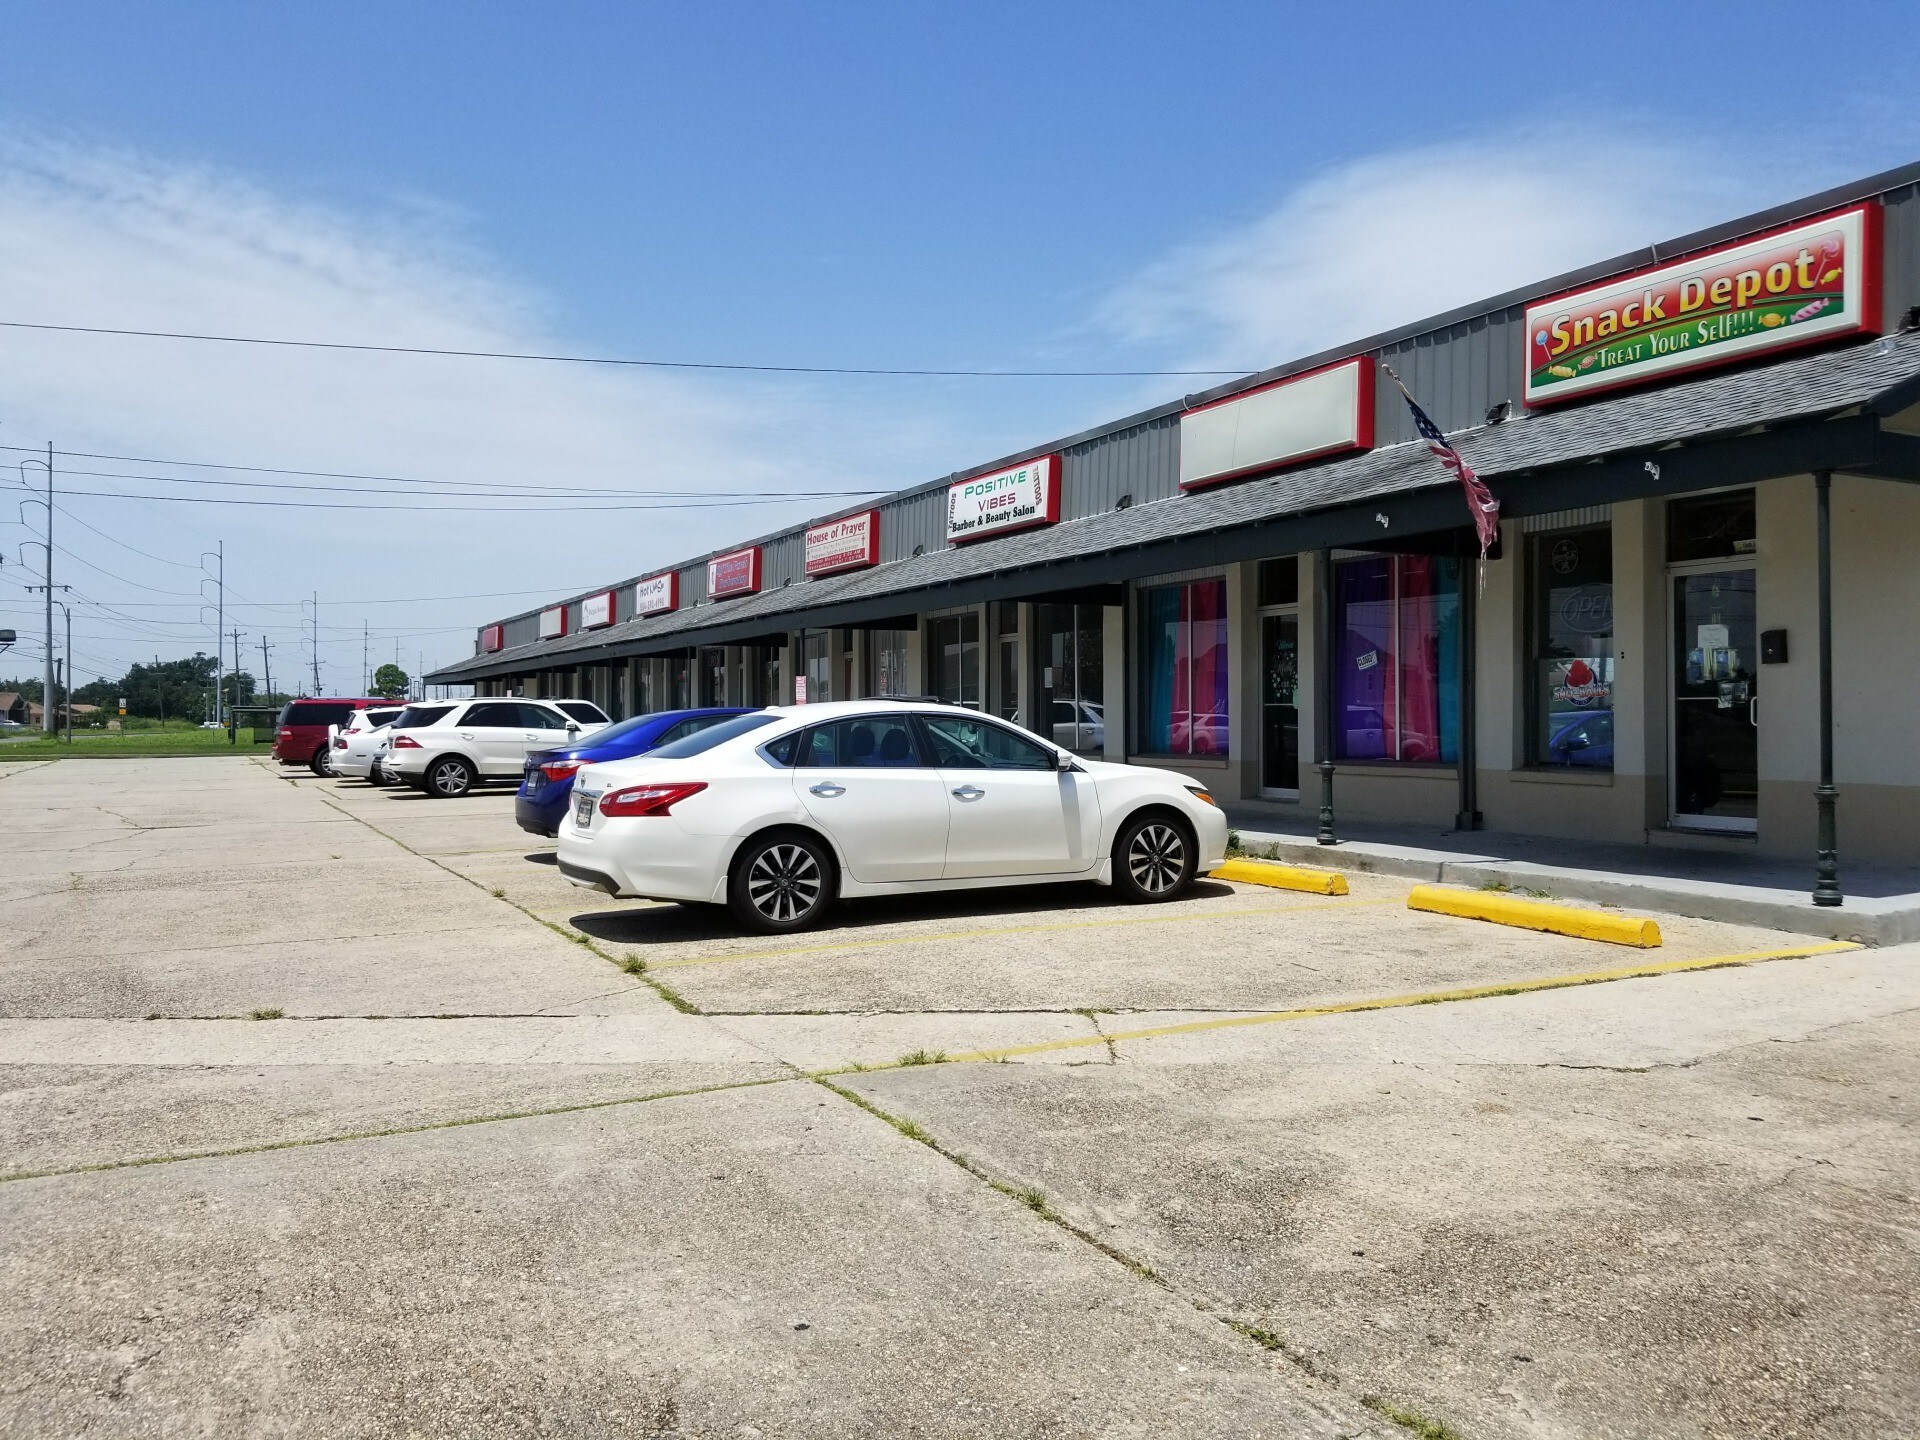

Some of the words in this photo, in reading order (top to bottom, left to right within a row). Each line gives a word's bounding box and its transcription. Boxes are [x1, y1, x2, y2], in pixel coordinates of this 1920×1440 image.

[1550, 289, 1667, 355] Snack
[1679, 248, 1816, 313] Depot
[964, 470, 1027, 499] POSITIVE
[1032, 465, 1043, 506] TATTOOS
[948, 493, 957, 529] TATTOOS
[978, 492, 1016, 512] VIBES
[807, 532, 828, 546] House
[831, 525, 839, 538] of
[841, 520, 866, 536] Prayer
[952, 519, 975, 532] Barber
[977, 515, 984, 526] &
[985, 510, 1011, 524] Beauty
[1013, 505, 1035, 517] Salon
